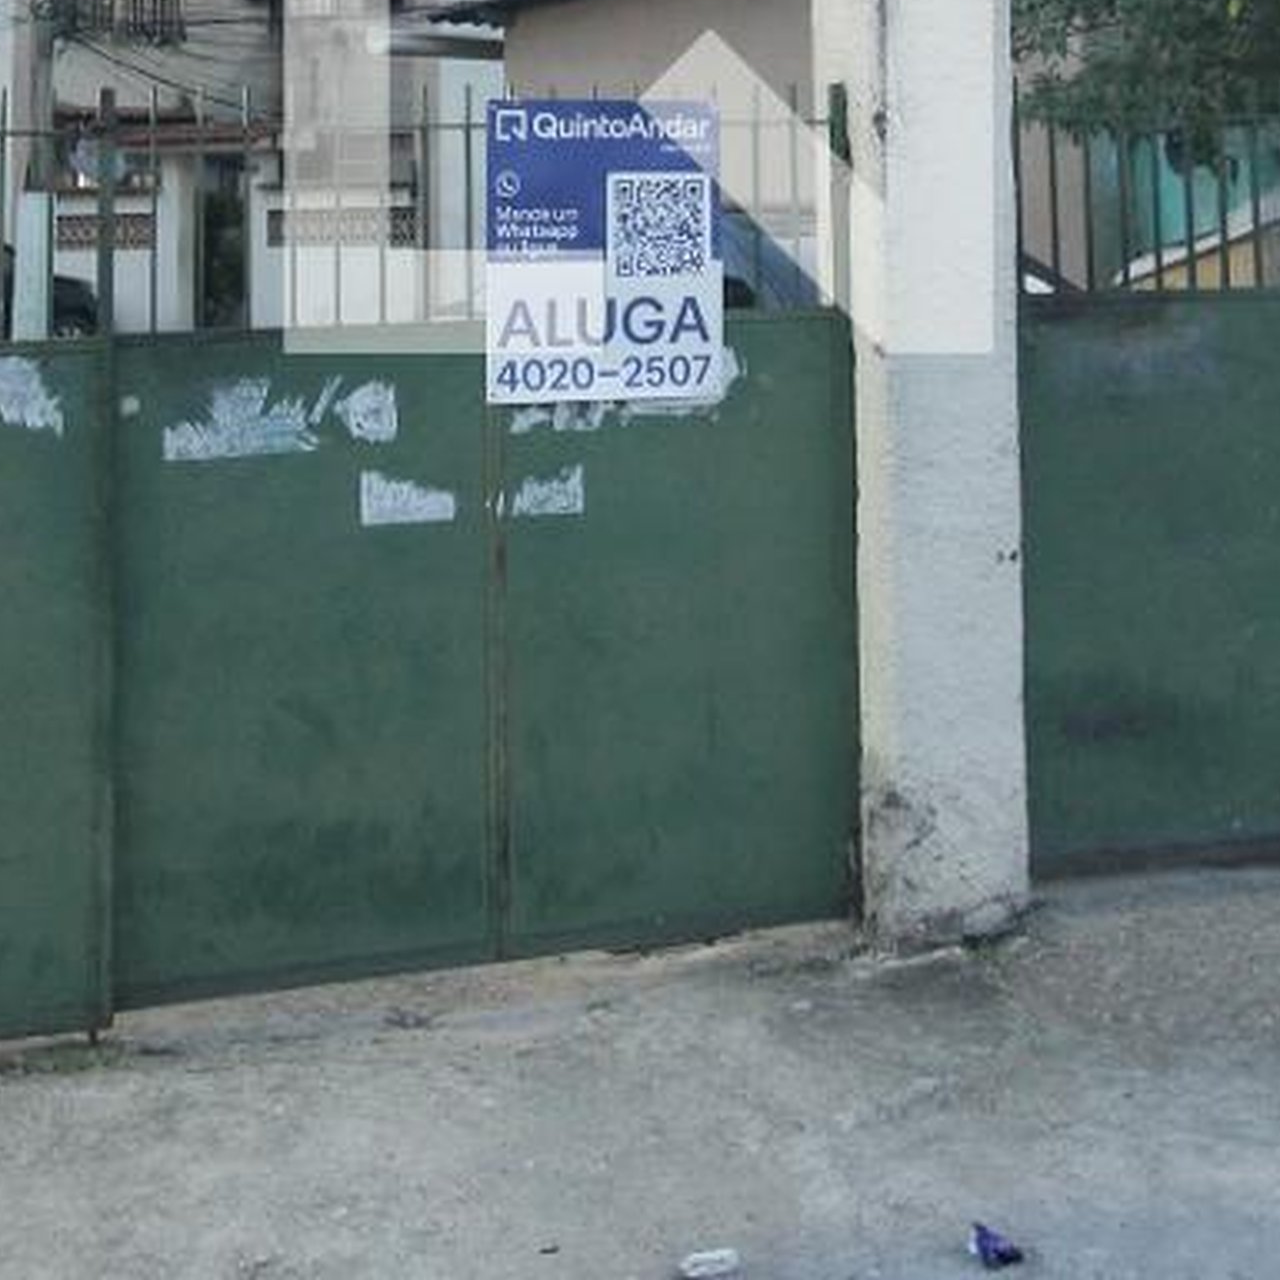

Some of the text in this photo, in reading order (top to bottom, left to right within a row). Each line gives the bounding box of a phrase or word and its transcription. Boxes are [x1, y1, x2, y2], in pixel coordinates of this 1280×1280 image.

[532, 111, 710, 140] QuintoAndar
[497, 296, 711, 348] ALUGA
[496, 356, 712, 393] 4020-2507
